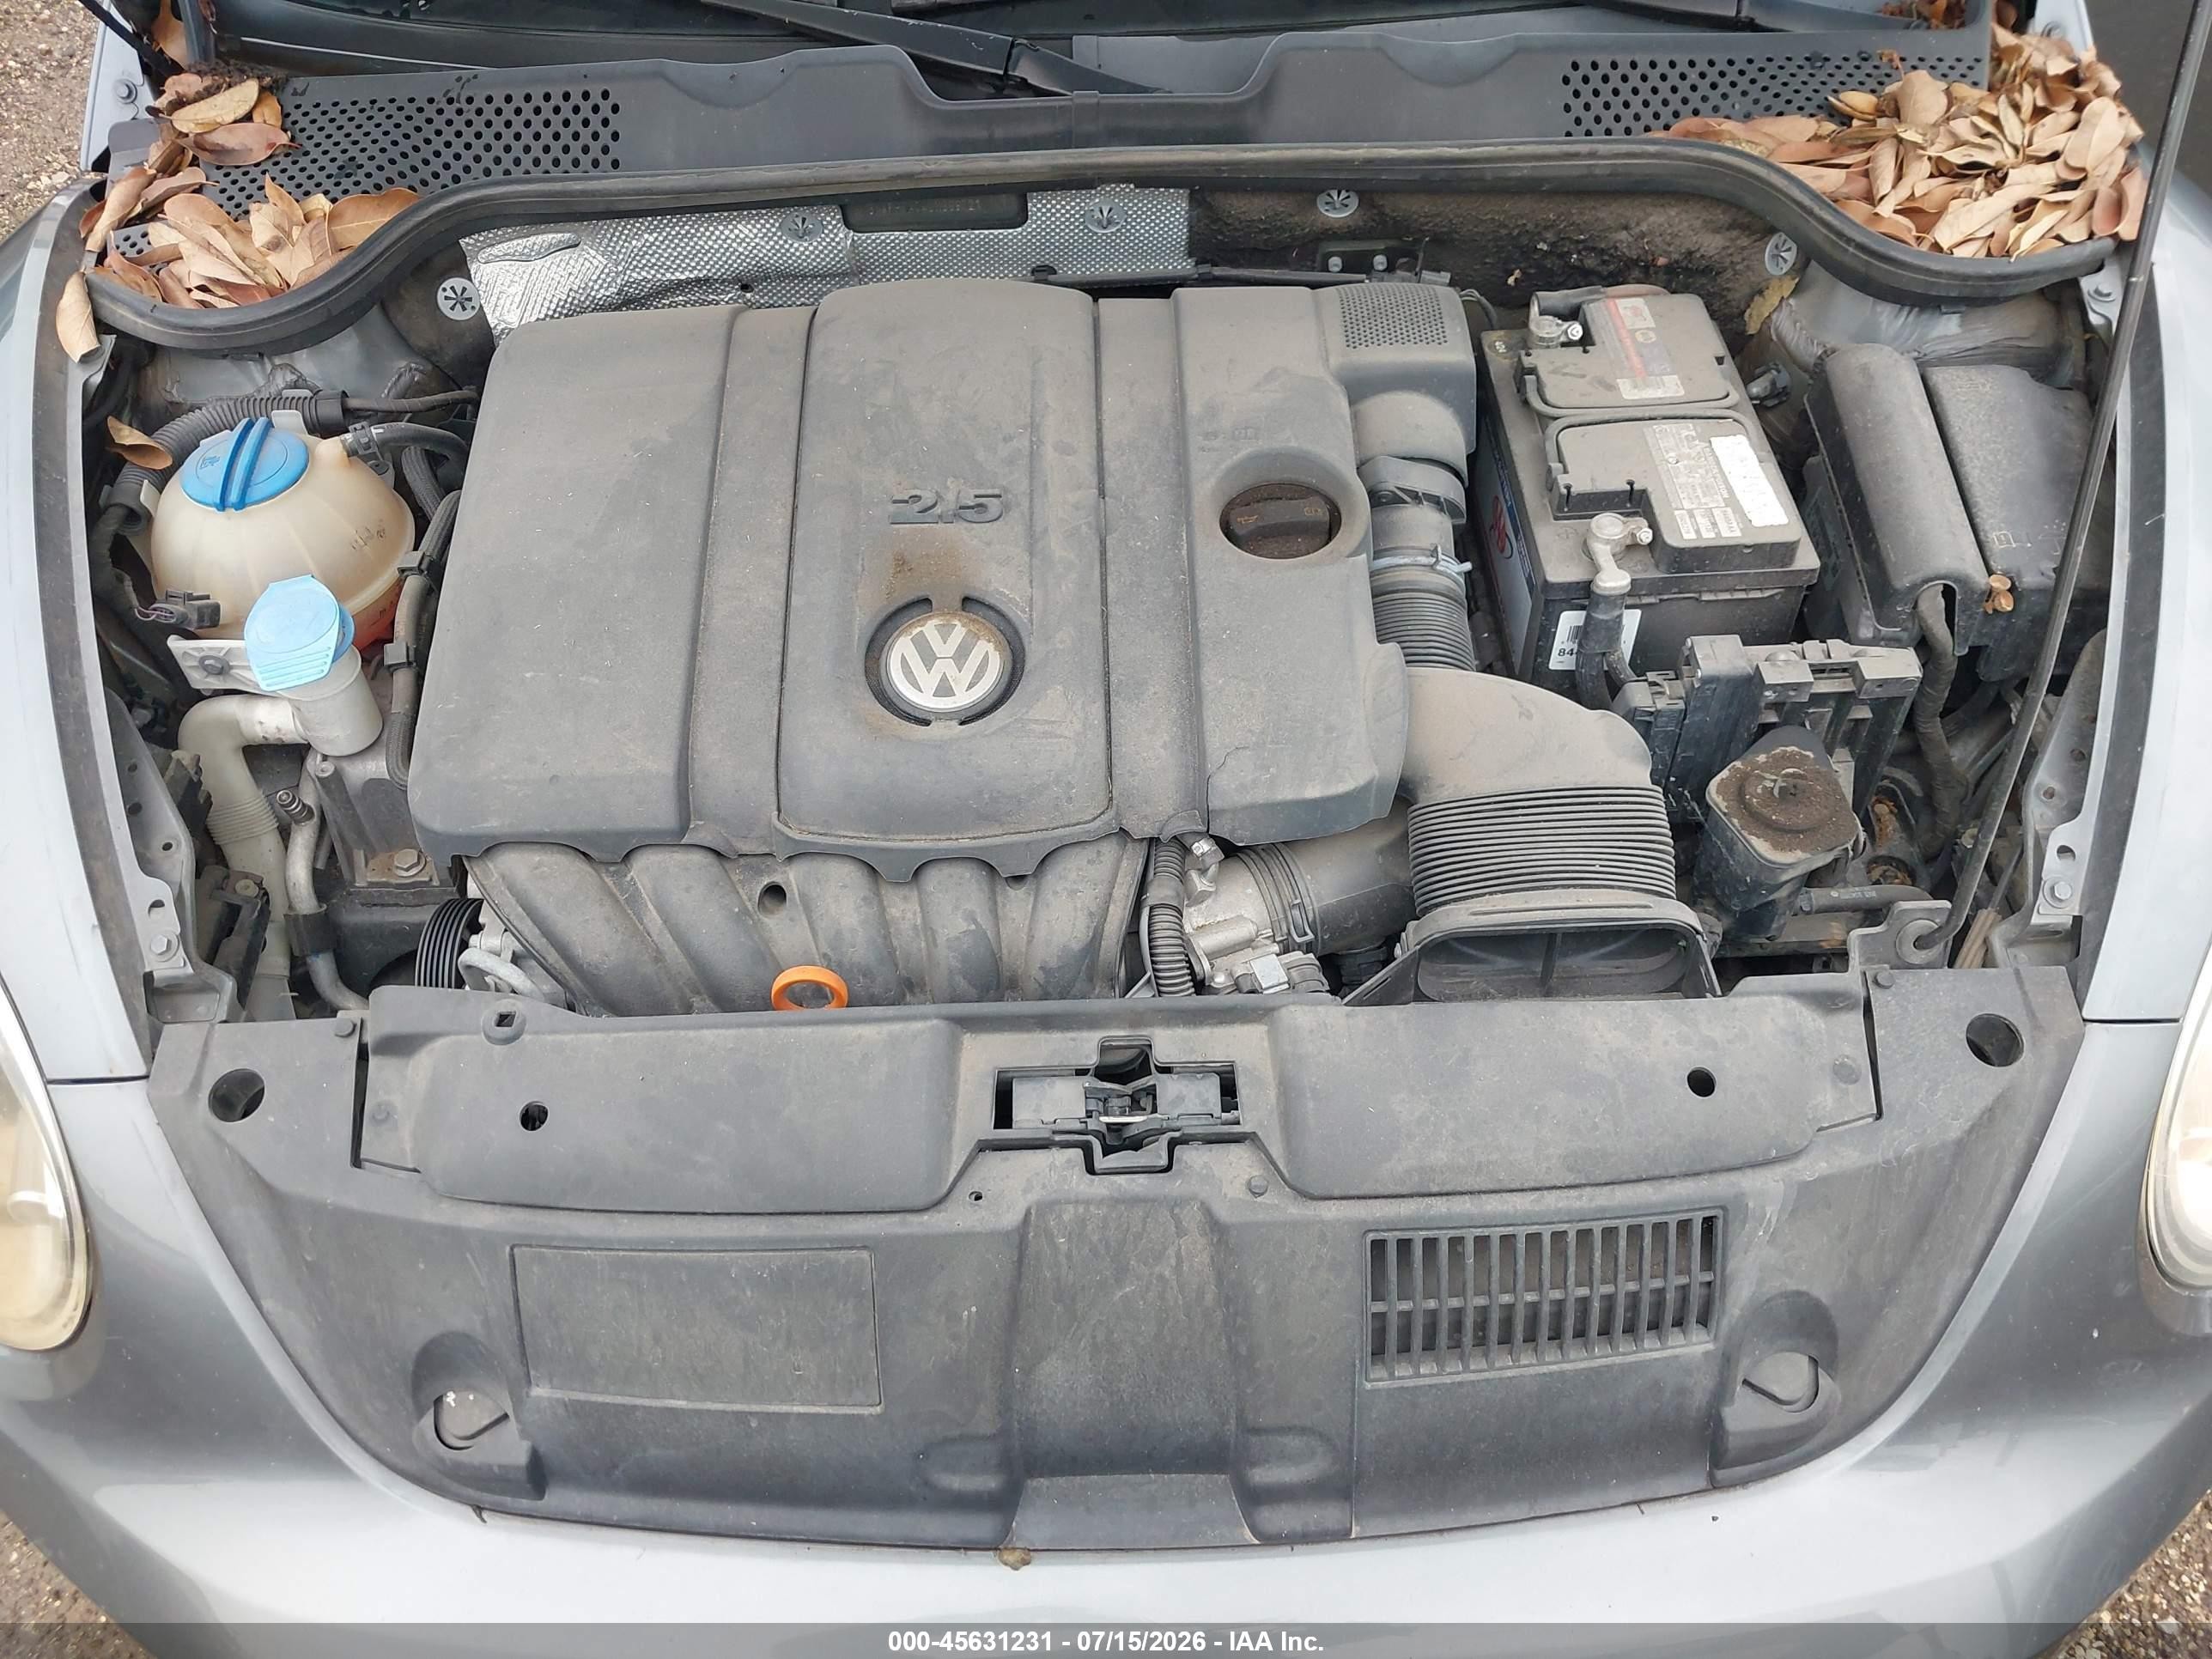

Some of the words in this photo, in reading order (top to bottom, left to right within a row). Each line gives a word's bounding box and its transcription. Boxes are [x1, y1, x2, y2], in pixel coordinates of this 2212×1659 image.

[889, 489, 1004, 524] 2.5
[890, 617, 1003, 711] VW
[1557, 647, 1577, 658] 84
